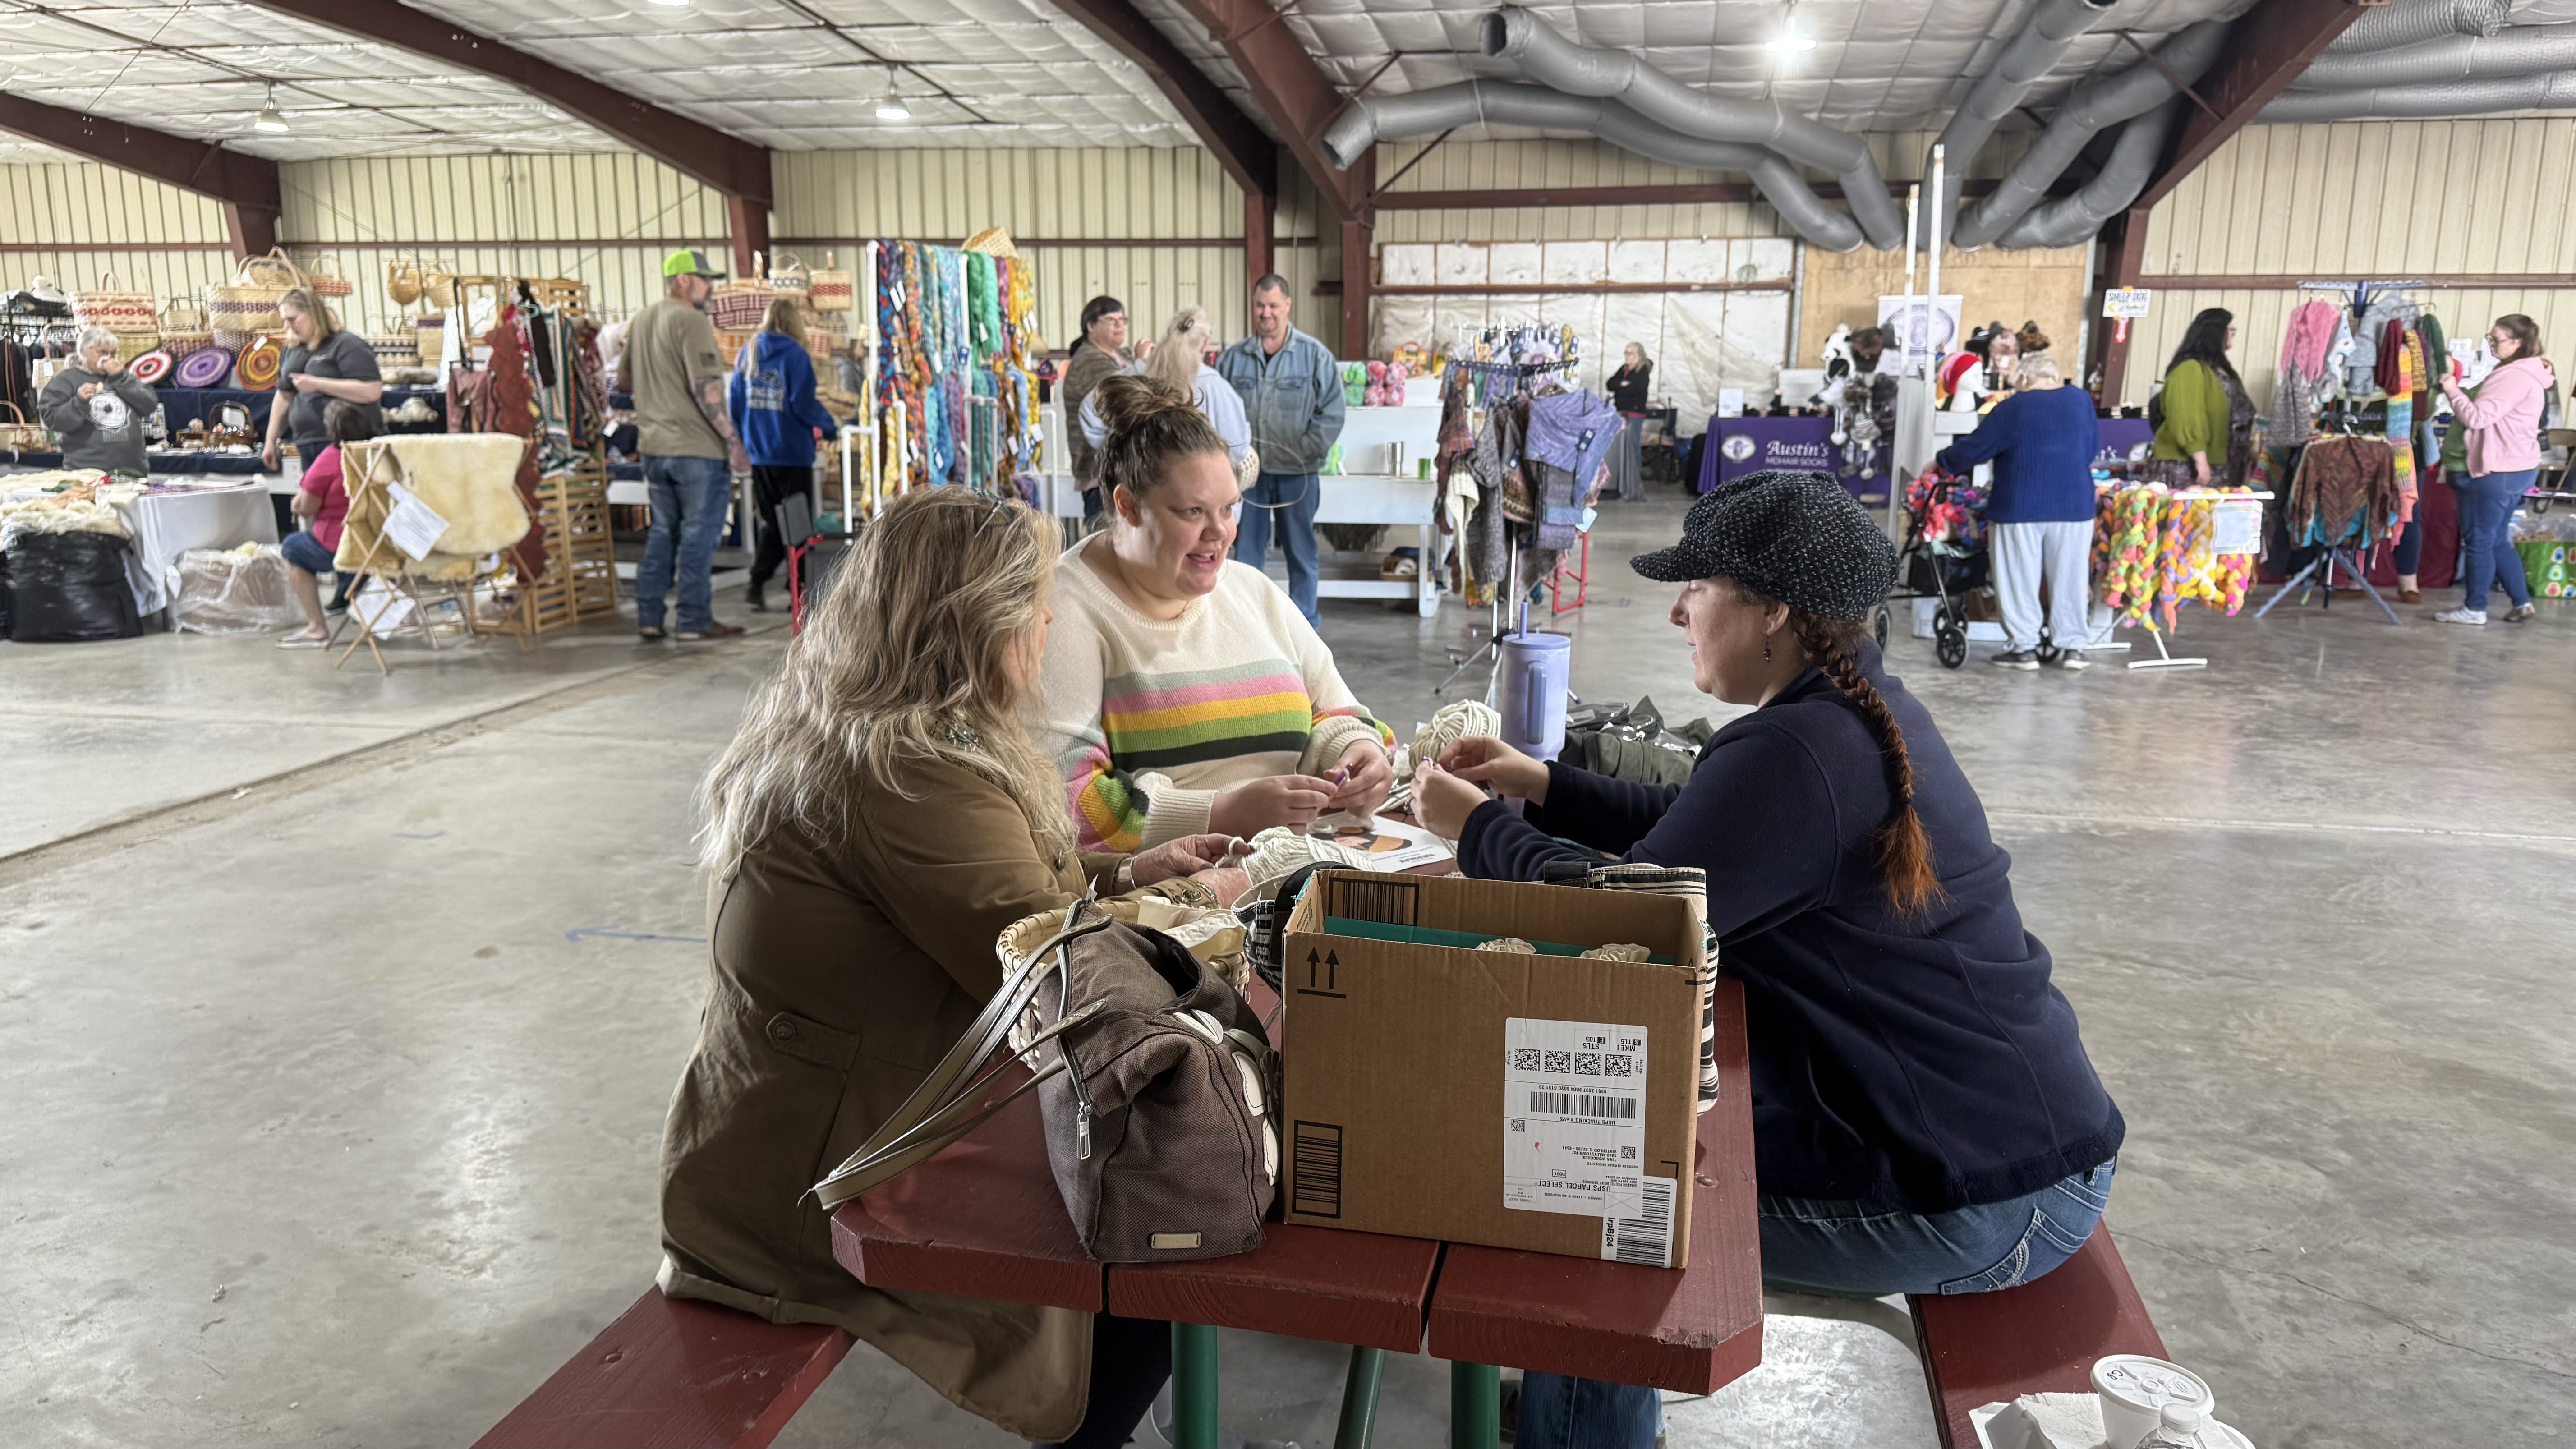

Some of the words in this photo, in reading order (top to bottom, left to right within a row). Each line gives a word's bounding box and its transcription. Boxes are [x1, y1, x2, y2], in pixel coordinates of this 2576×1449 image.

[1767, 440, 1830, 457] Austin's
[1538, 1180, 1563, 1188] SELECT
[1593, 1184, 1611, 1192] USPS
